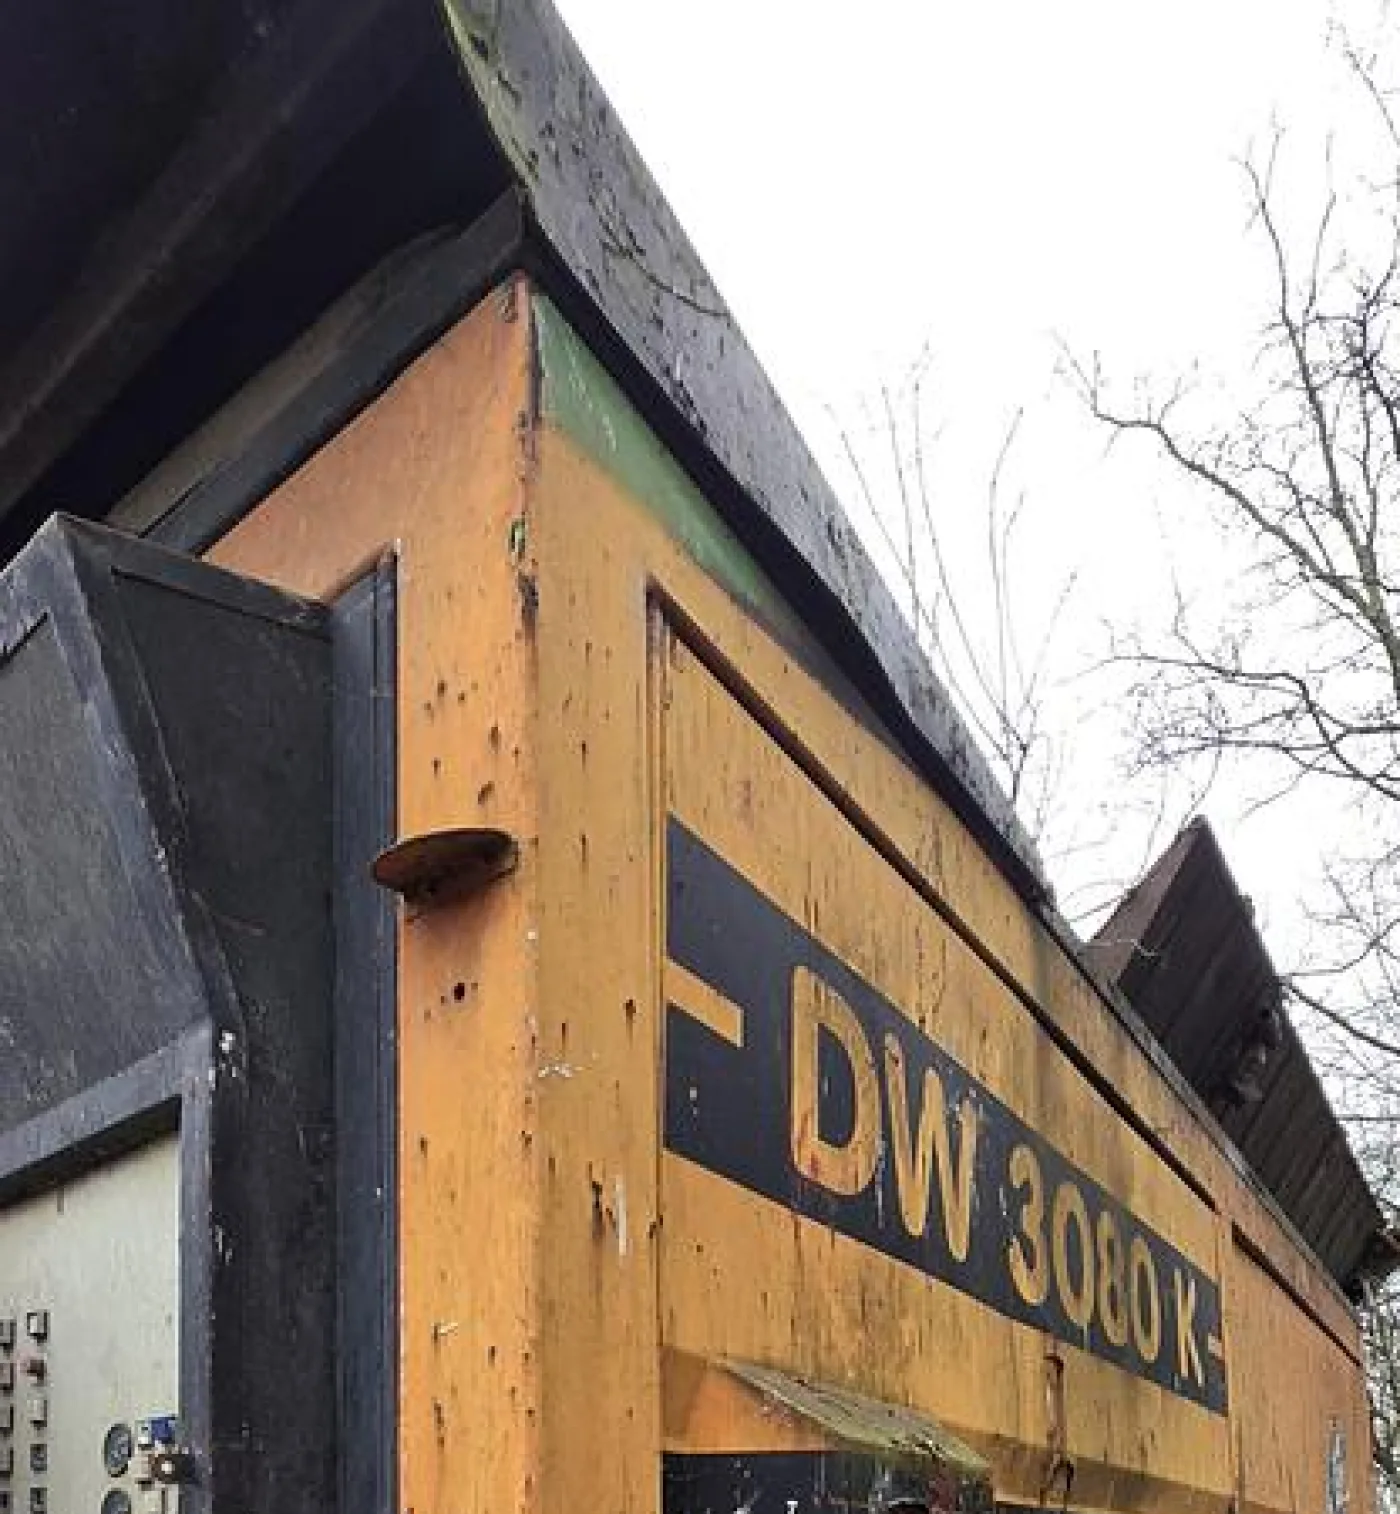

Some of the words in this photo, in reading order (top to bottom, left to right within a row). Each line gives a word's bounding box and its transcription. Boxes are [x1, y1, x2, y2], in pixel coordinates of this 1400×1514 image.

[790, 964, 977, 1263] DW
[1009, 1144, 1162, 1361] 3080
[1173, 1267, 1204, 1388] K
